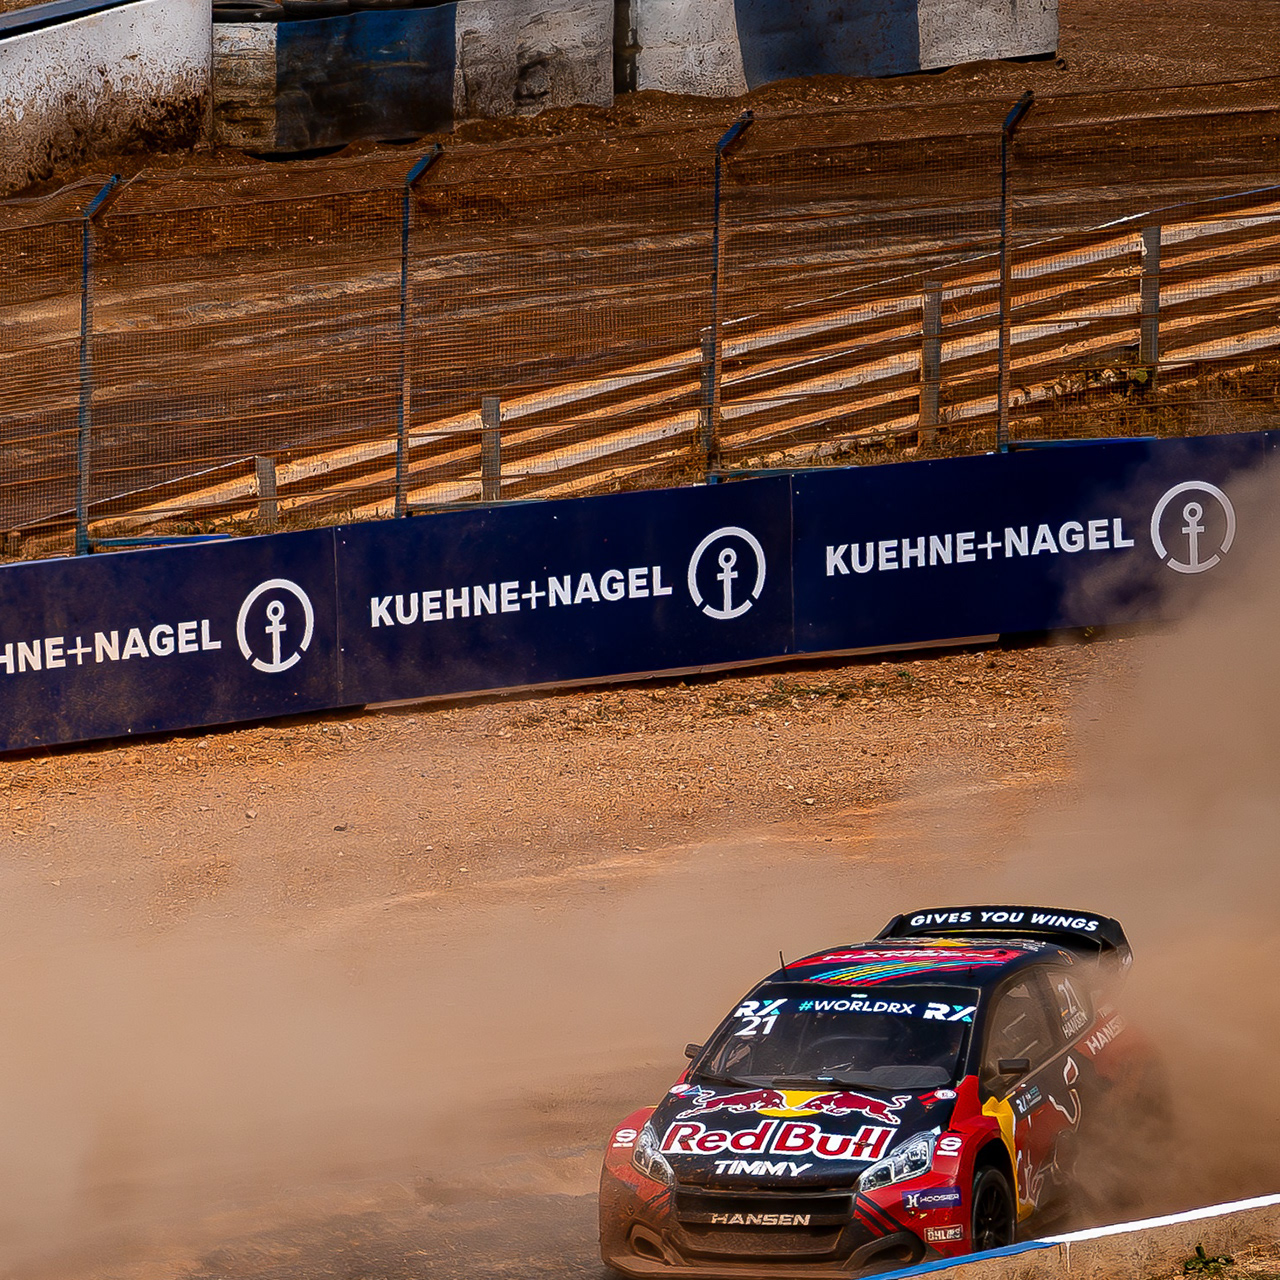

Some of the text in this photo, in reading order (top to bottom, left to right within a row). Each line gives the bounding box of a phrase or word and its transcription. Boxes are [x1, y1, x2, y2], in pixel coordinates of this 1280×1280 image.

[825, 517, 1135, 577] KUEHNE+NAGEL
[370, 565, 673, 628] KUEHNE+NAGEL
[910, 911, 1099, 932] GIVES YOU WINGS
[798, 1000, 916, 1014] #WORLDRX
[734, 1015, 778, 1036] 21
[660, 1120, 897, 1161] Red Bull
[713, 1160, 813, 1177] TIMMY
[711, 1213, 811, 1226] HANSEN
